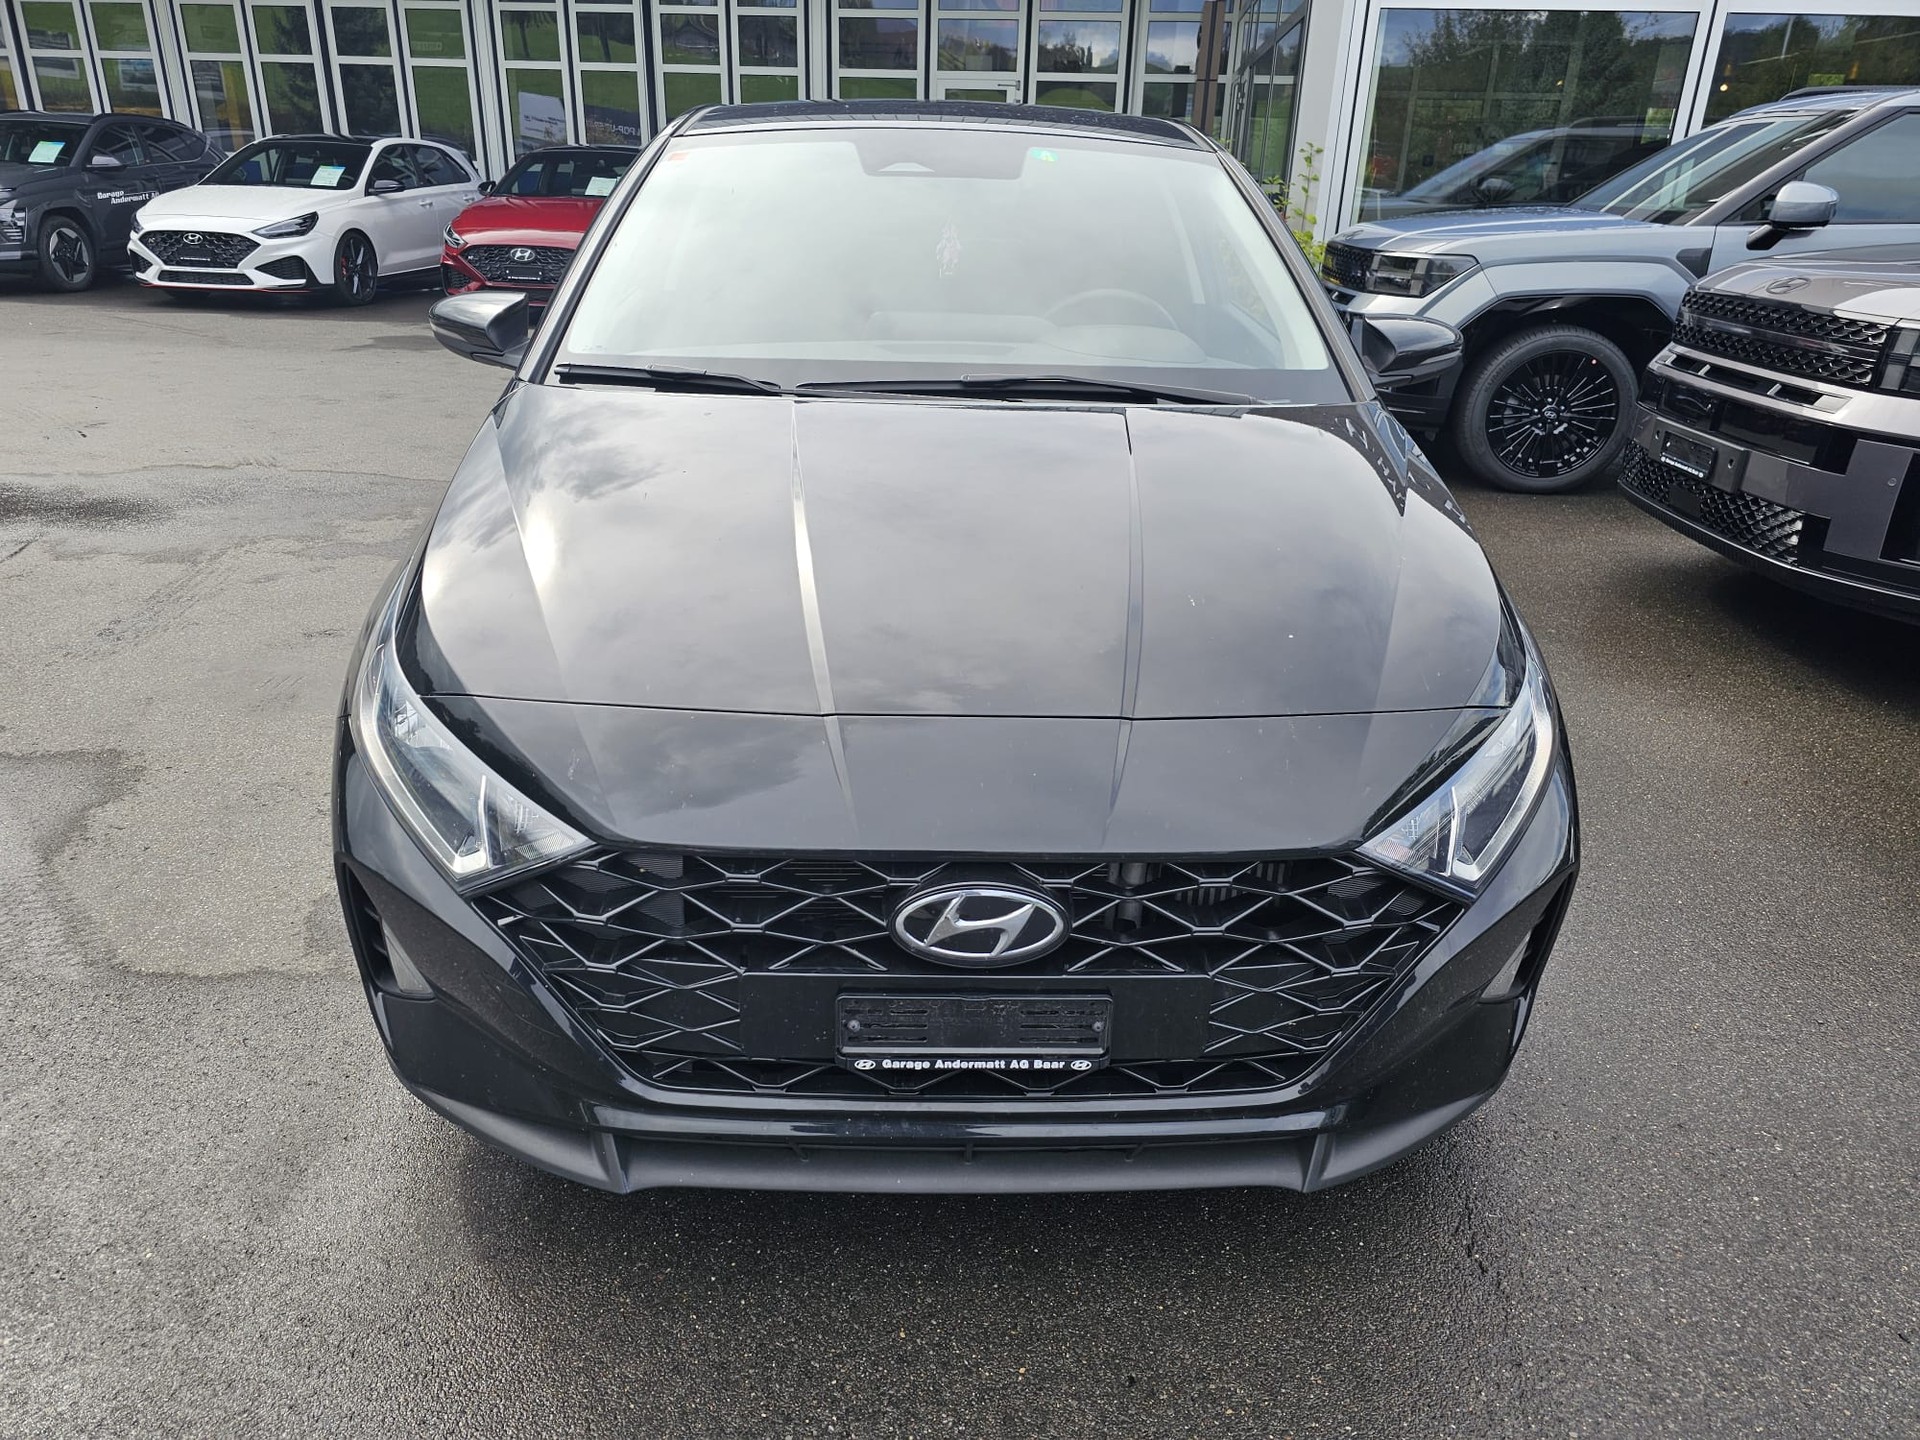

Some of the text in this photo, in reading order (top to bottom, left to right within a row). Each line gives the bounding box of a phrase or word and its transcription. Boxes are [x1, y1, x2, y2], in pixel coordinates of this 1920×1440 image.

[97, 190, 125, 200] Garage
[110, 193, 149, 204] Andermatt
[882, 1059, 1066, 1071] Garage Andermatt AG Baar
